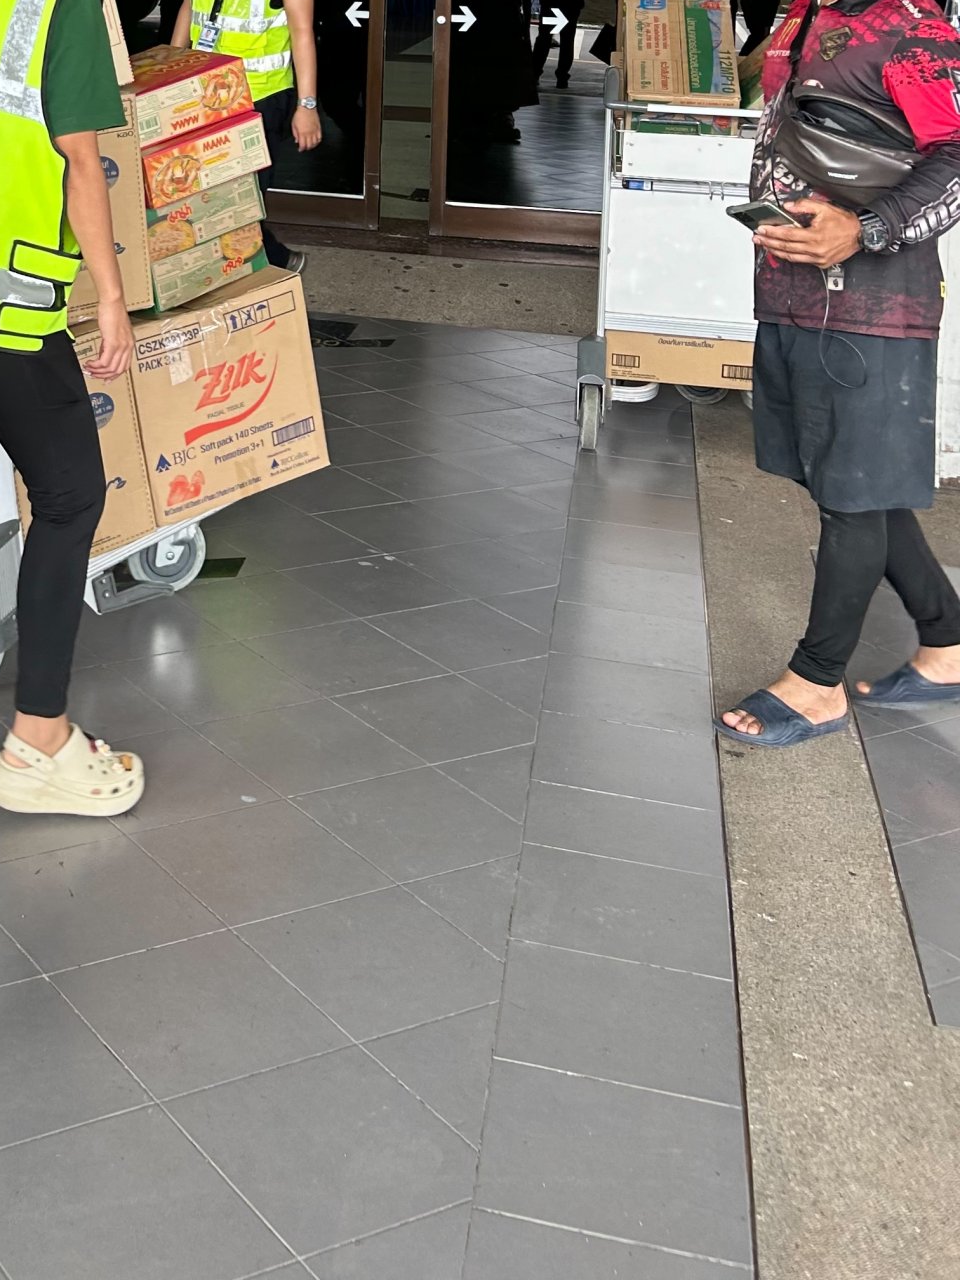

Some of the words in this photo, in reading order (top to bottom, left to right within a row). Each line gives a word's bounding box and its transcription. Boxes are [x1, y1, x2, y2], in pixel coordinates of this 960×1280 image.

[719, 50, 736, 94] 112MP10
[171, 114, 199, 131] MAMA
[203, 135, 230, 152] MAMA
[139, 357, 162, 372] PACK
[194, 350, 267, 412] Zilk
[235, 430, 249, 441] 140
[250, 421, 274, 435] Sheets
[172, 447, 197, 466] BJC
[214, 446, 250, 464] Promotion
[251, 439, 265, 451] 3+1
